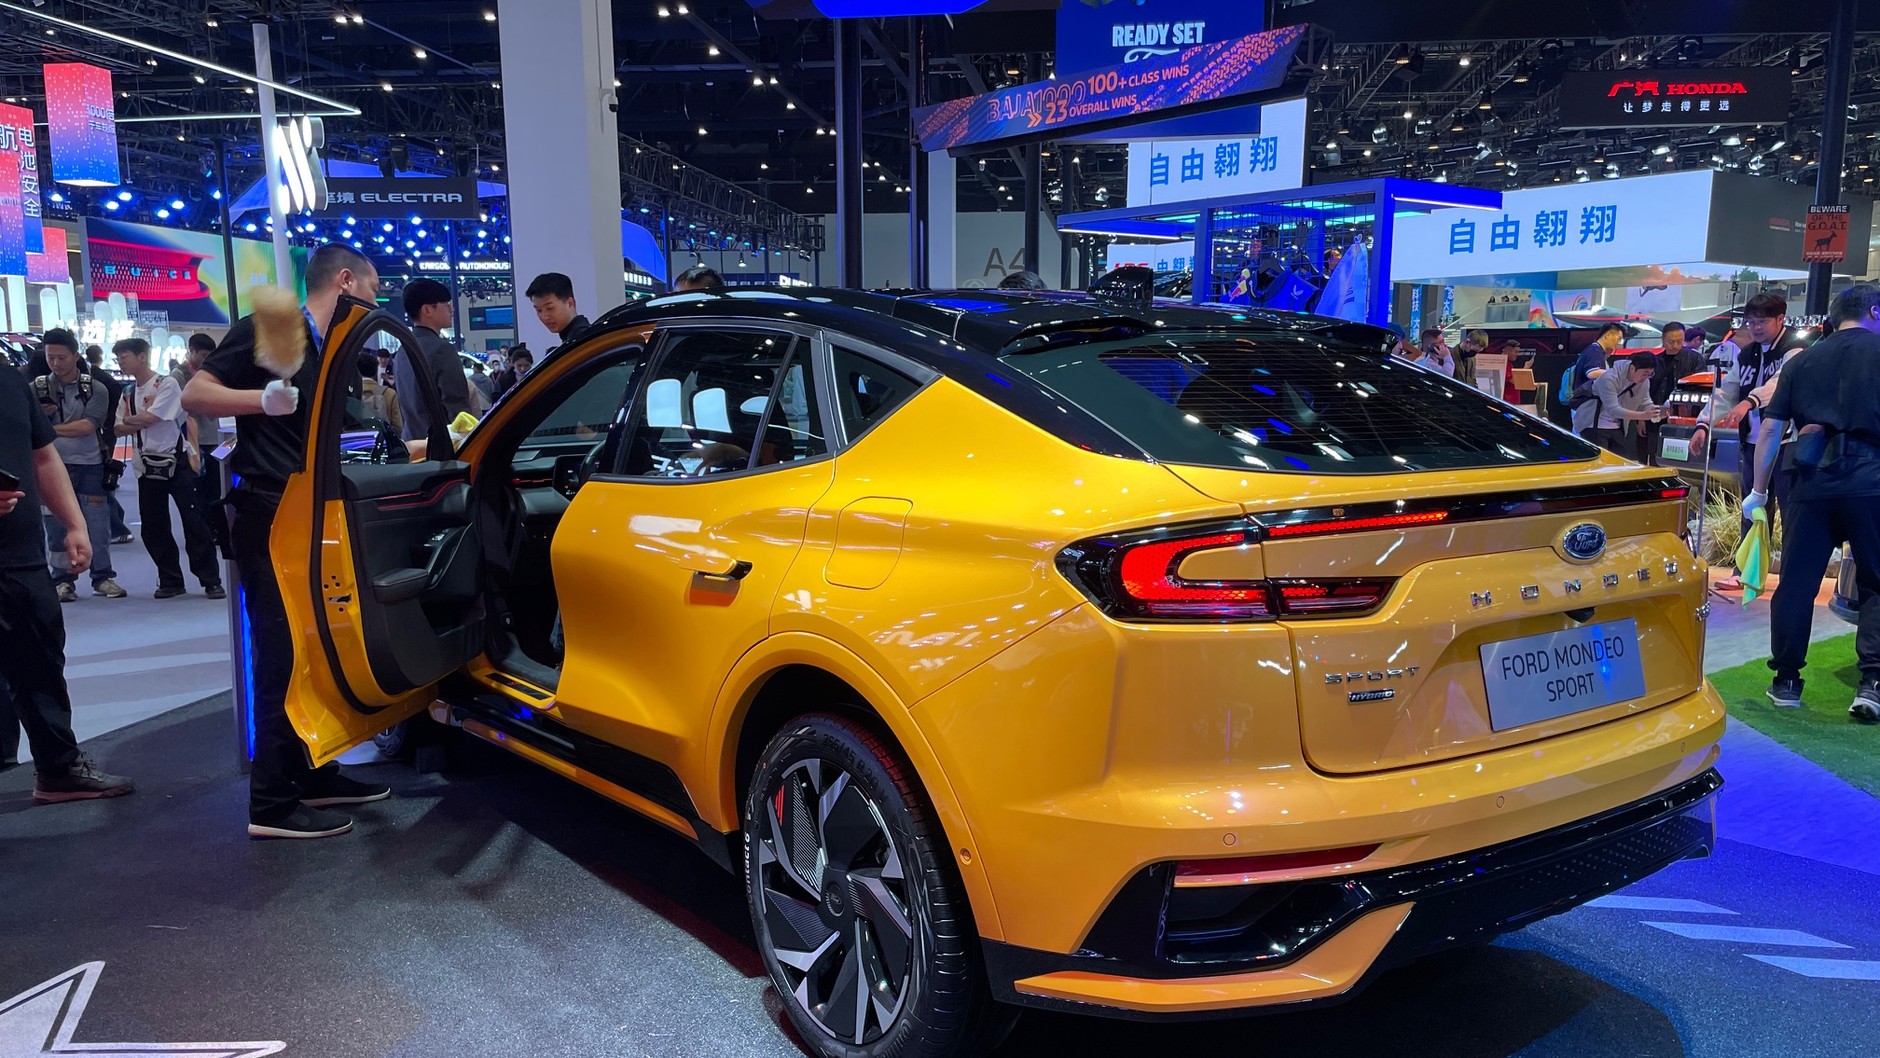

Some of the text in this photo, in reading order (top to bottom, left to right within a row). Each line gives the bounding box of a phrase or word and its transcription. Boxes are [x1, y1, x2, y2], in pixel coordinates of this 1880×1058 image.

[1112, 22, 1206, 47] READY SET
[1088, 64, 1190, 95] 100+ CLASS WINS
[1607, 80, 1748, 97] 广汽 HONDA
[1044, 94, 1137, 124] 23 OVERALL WINS
[18, 127, 40, 217] 电池安全
[1150, 136, 1278, 187] 自由翱翔
[360, 193, 463, 203] ELECTRA
[1810, 205, 1848, 213] BEWARE
[1449, 204, 1617, 255] 自由翱翔
[1669, 394, 1712, 403] BRONC
[1574, 531, 1600, 550] Ford
[1470, 561, 1678, 607] MONDEO
[1501, 636, 1624, 680] FORD MONDEO
[1325, 667, 1420, 683] SPORT
[1546, 672, 1595, 702] SPORT
[1350, 690, 1394, 701] HYBRID
